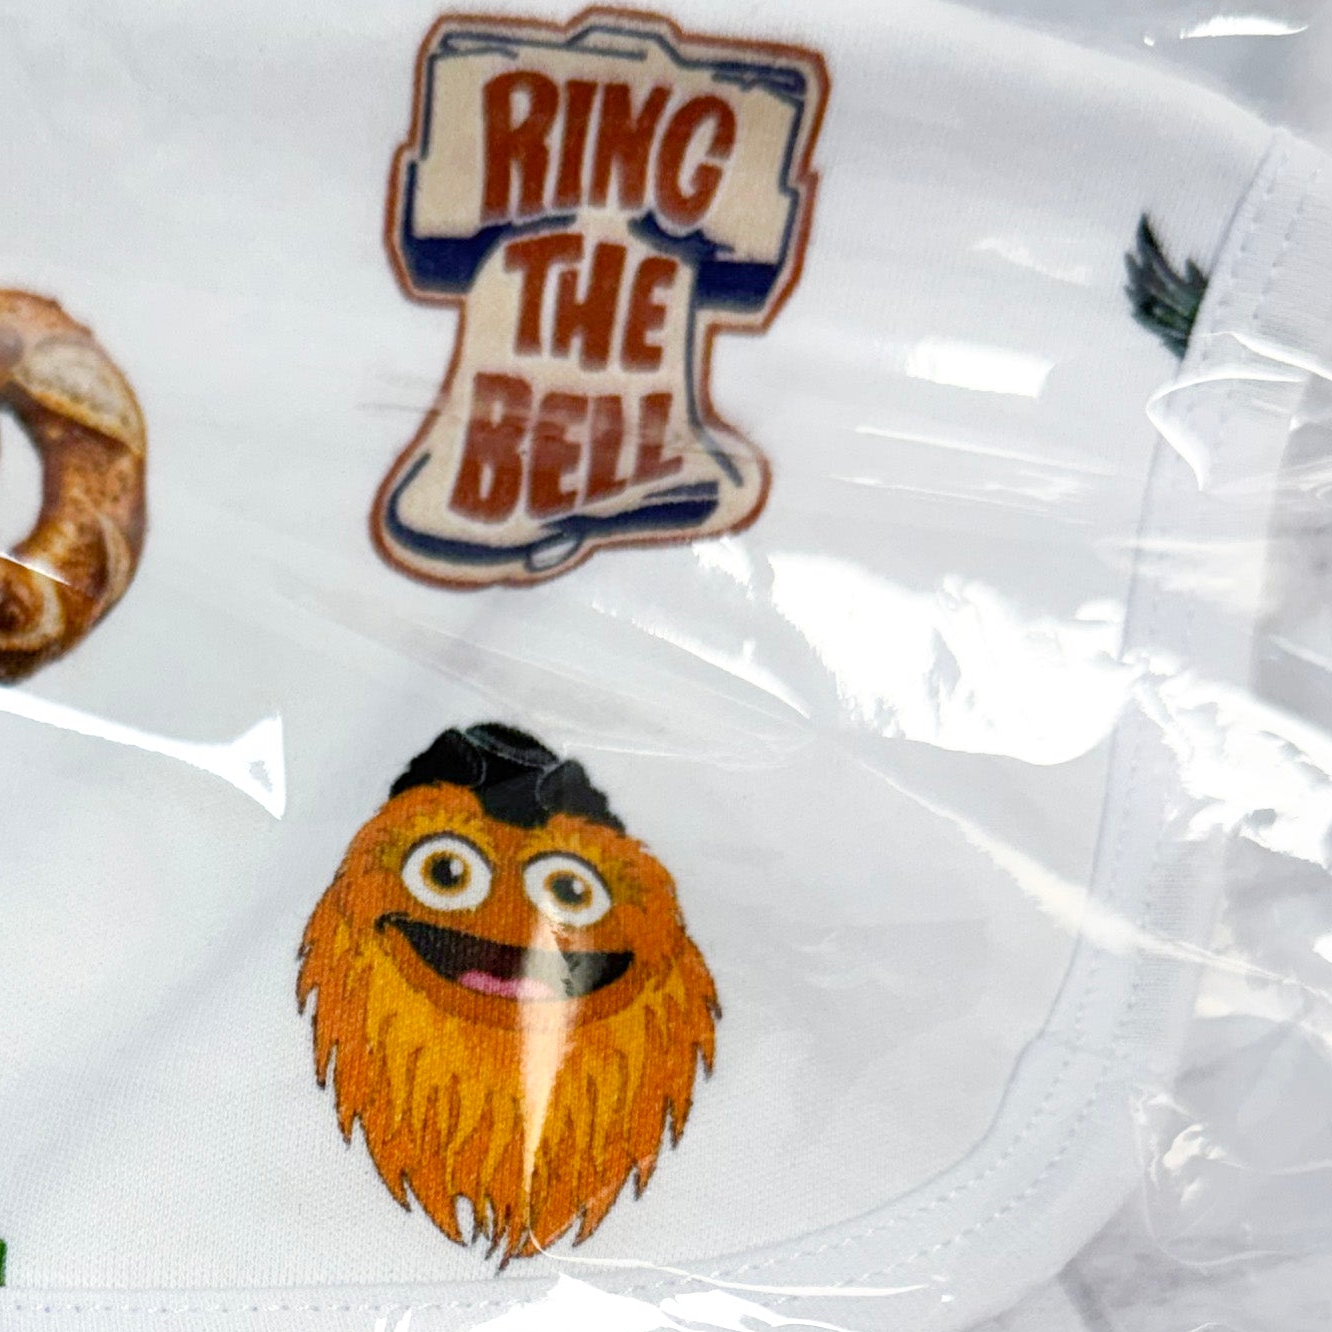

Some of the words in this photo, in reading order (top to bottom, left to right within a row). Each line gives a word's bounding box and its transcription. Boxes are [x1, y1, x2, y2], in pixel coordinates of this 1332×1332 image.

[479, 70, 738, 226] RING
[503, 232, 681, 372] THE
[448, 371, 684, 524] BELL
